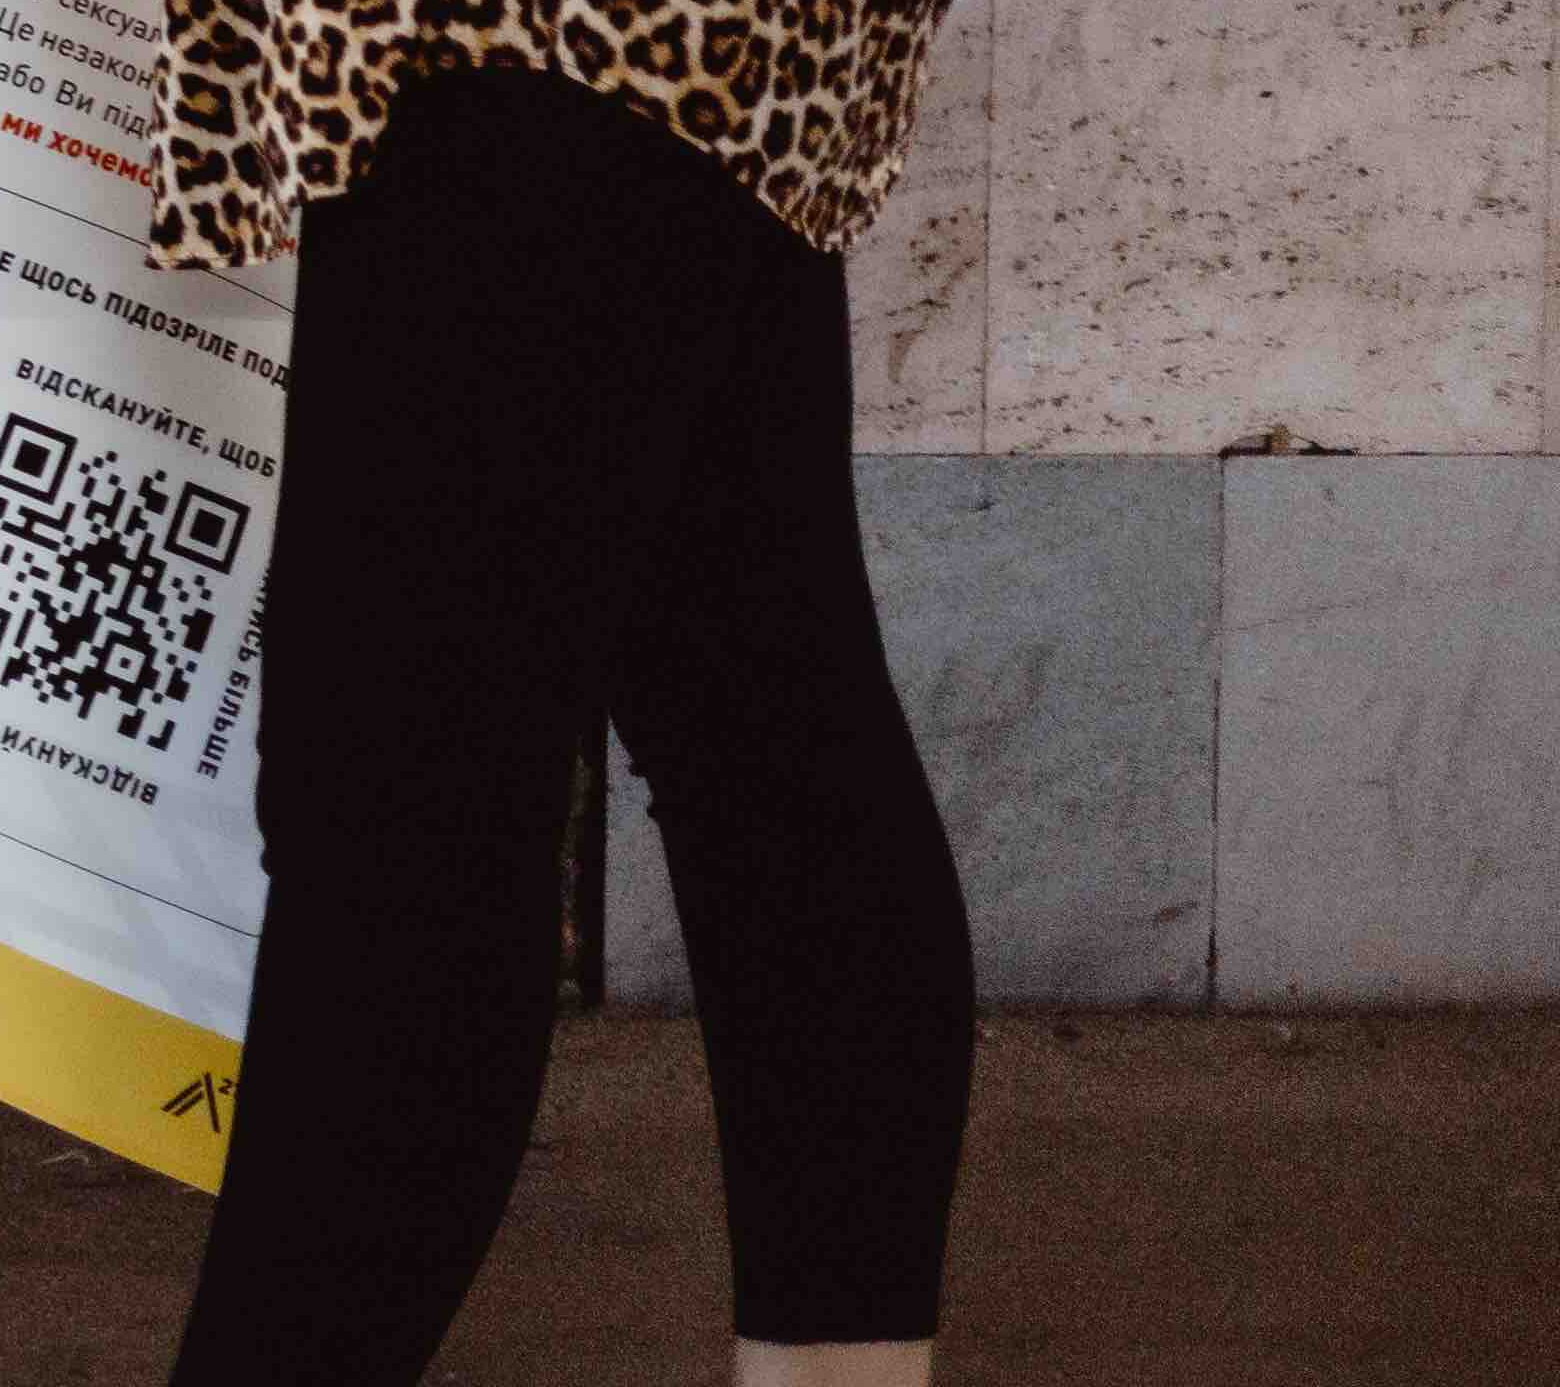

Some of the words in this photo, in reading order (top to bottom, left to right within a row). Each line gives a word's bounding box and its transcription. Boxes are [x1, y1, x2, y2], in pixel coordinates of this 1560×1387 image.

[55, 79, 96, 115] Ви
[19, 258, 98, 306] ЩОСЬ
[103, 291, 239, 364] ПІДОЗРІЛЕ
[15, 357, 211, 455] ВІДСКАНУЙТЕ,
[218, 437, 278, 478] ЩОБ
[197, 670, 251, 780] БІЛЬШЕ
